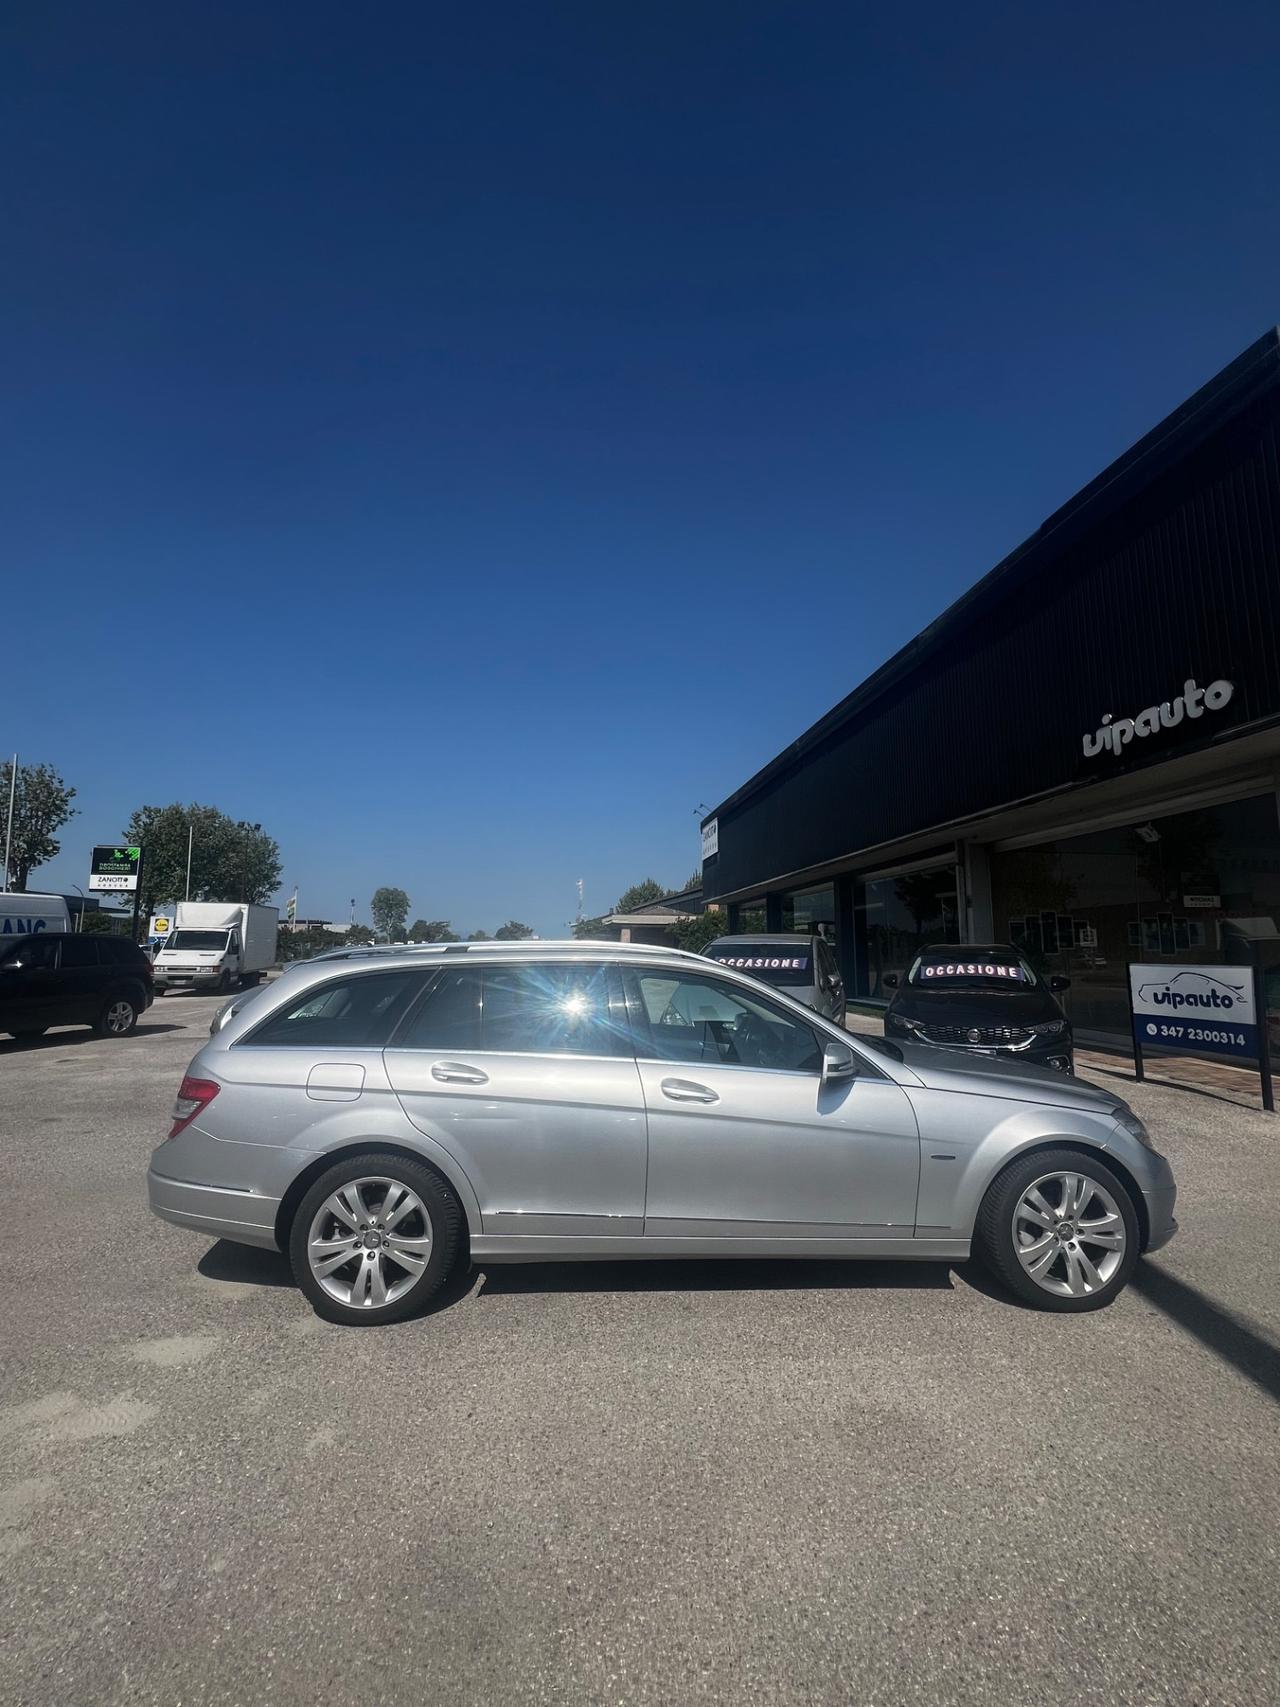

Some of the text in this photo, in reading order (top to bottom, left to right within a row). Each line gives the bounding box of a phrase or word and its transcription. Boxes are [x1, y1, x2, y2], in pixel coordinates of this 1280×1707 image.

[1082, 678, 1234, 757] vipauto
[925, 964, 1018, 978] OCCASIONE
[1153, 986, 1234, 1010] vipauto
[1160, 1025, 1246, 1046] 347 2300314
